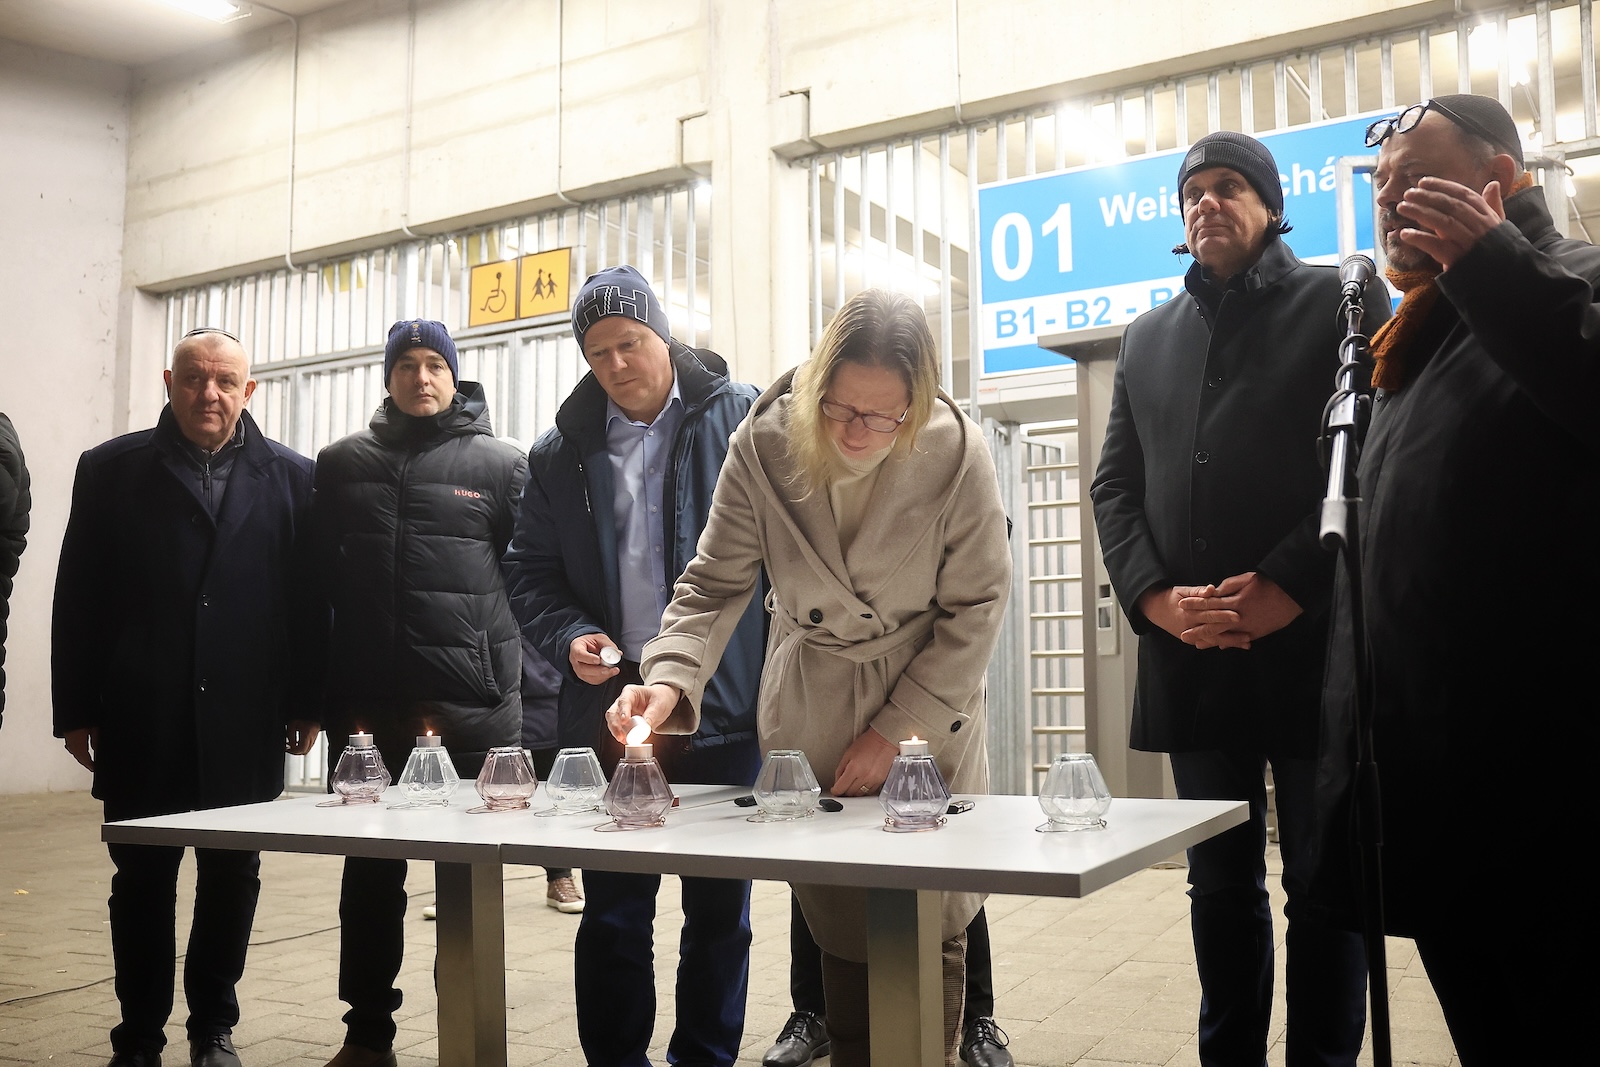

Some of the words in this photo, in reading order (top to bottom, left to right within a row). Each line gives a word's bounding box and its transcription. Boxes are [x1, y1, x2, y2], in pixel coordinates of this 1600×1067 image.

[1099, 185, 1181, 228] Weis
[1279, 156, 1336, 198] chá
[991, 203, 1074, 282] 01
[574, 286, 649, 334] HH
[995, 305, 1035, 339] B1
[1066, 296, 1112, 330] B2
[454, 489, 481, 499] HUGO
